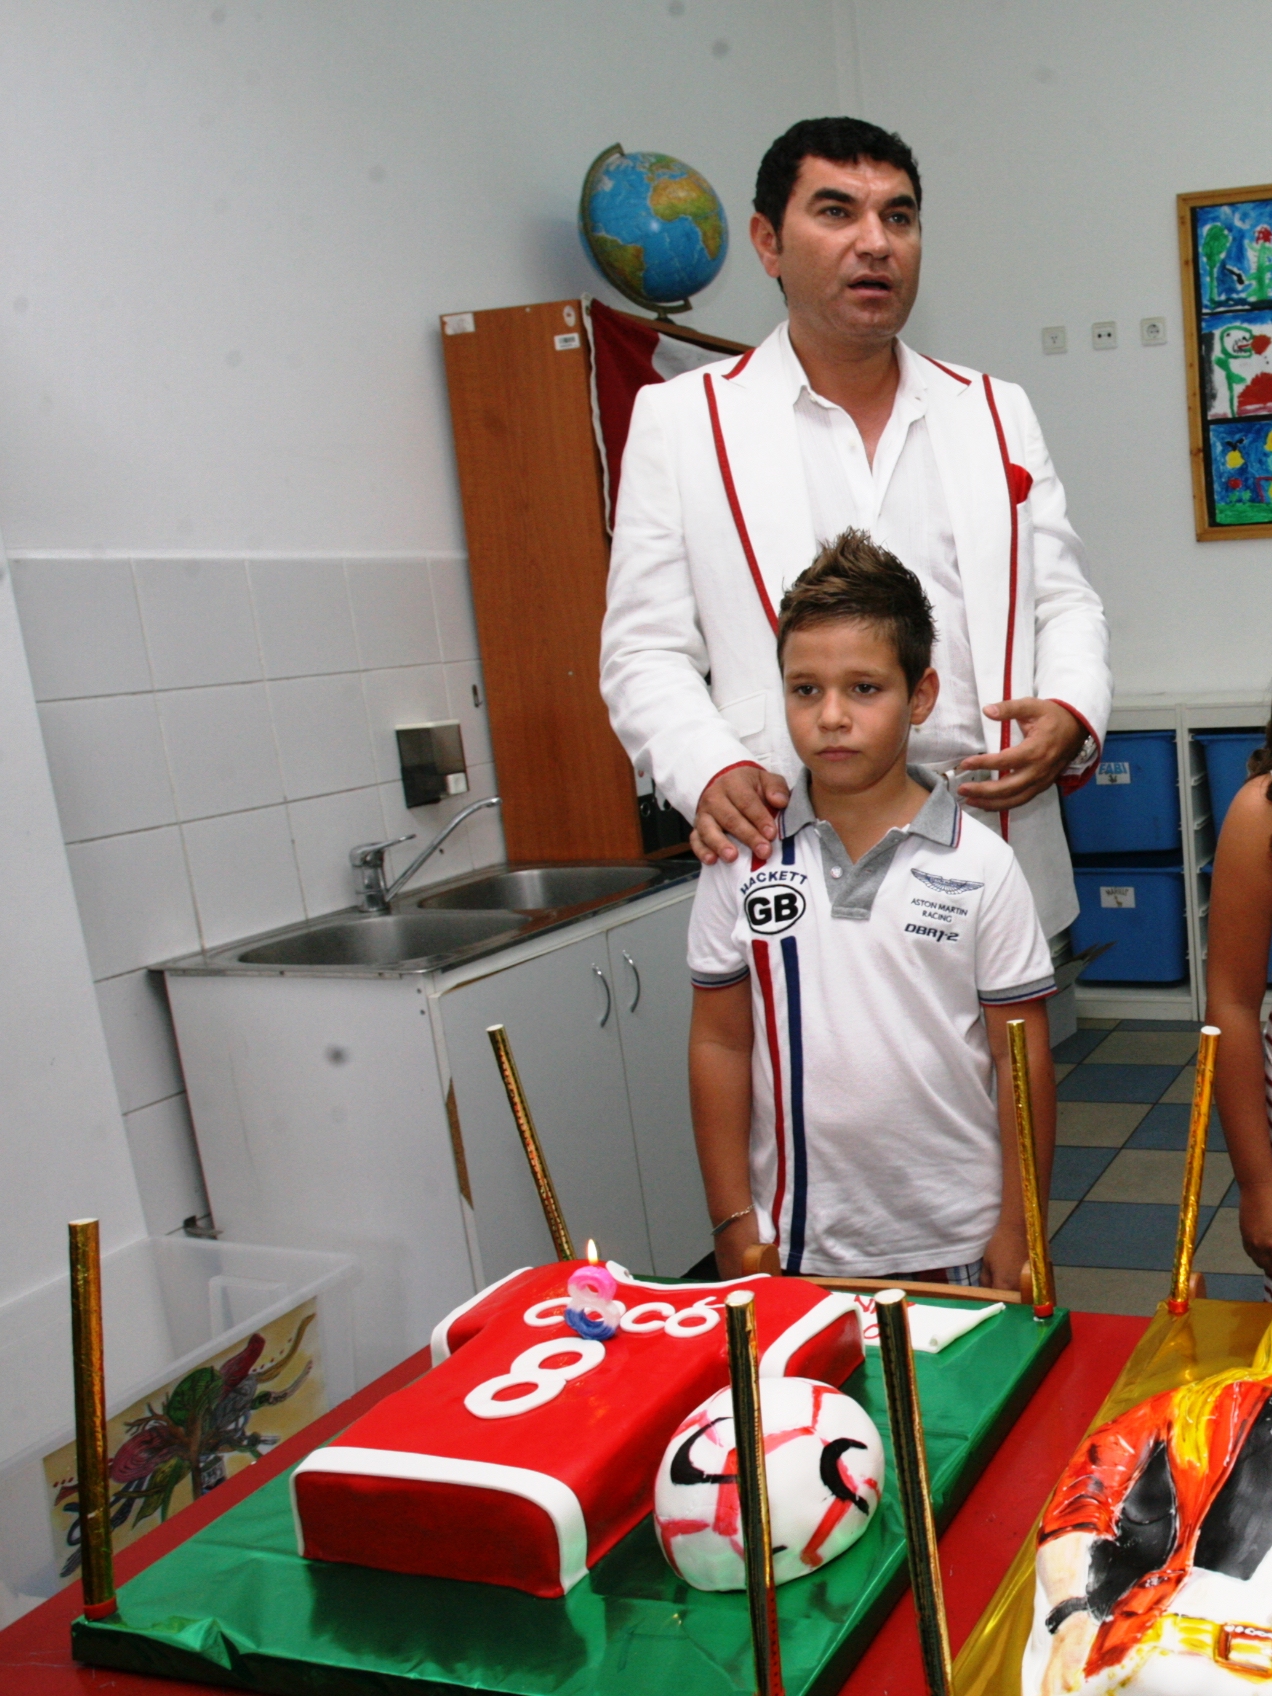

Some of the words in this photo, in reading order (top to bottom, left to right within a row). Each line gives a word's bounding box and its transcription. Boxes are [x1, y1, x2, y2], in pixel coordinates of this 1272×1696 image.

[740, 870, 808, 895] HACKETT
[747, 893, 799, 926] GB
[911, 898, 938, 909] ASTON
[938, 904, 968, 917] MARTIN
[922, 910, 953, 923] RACING
[464, 1336, 606, 1420] 8
